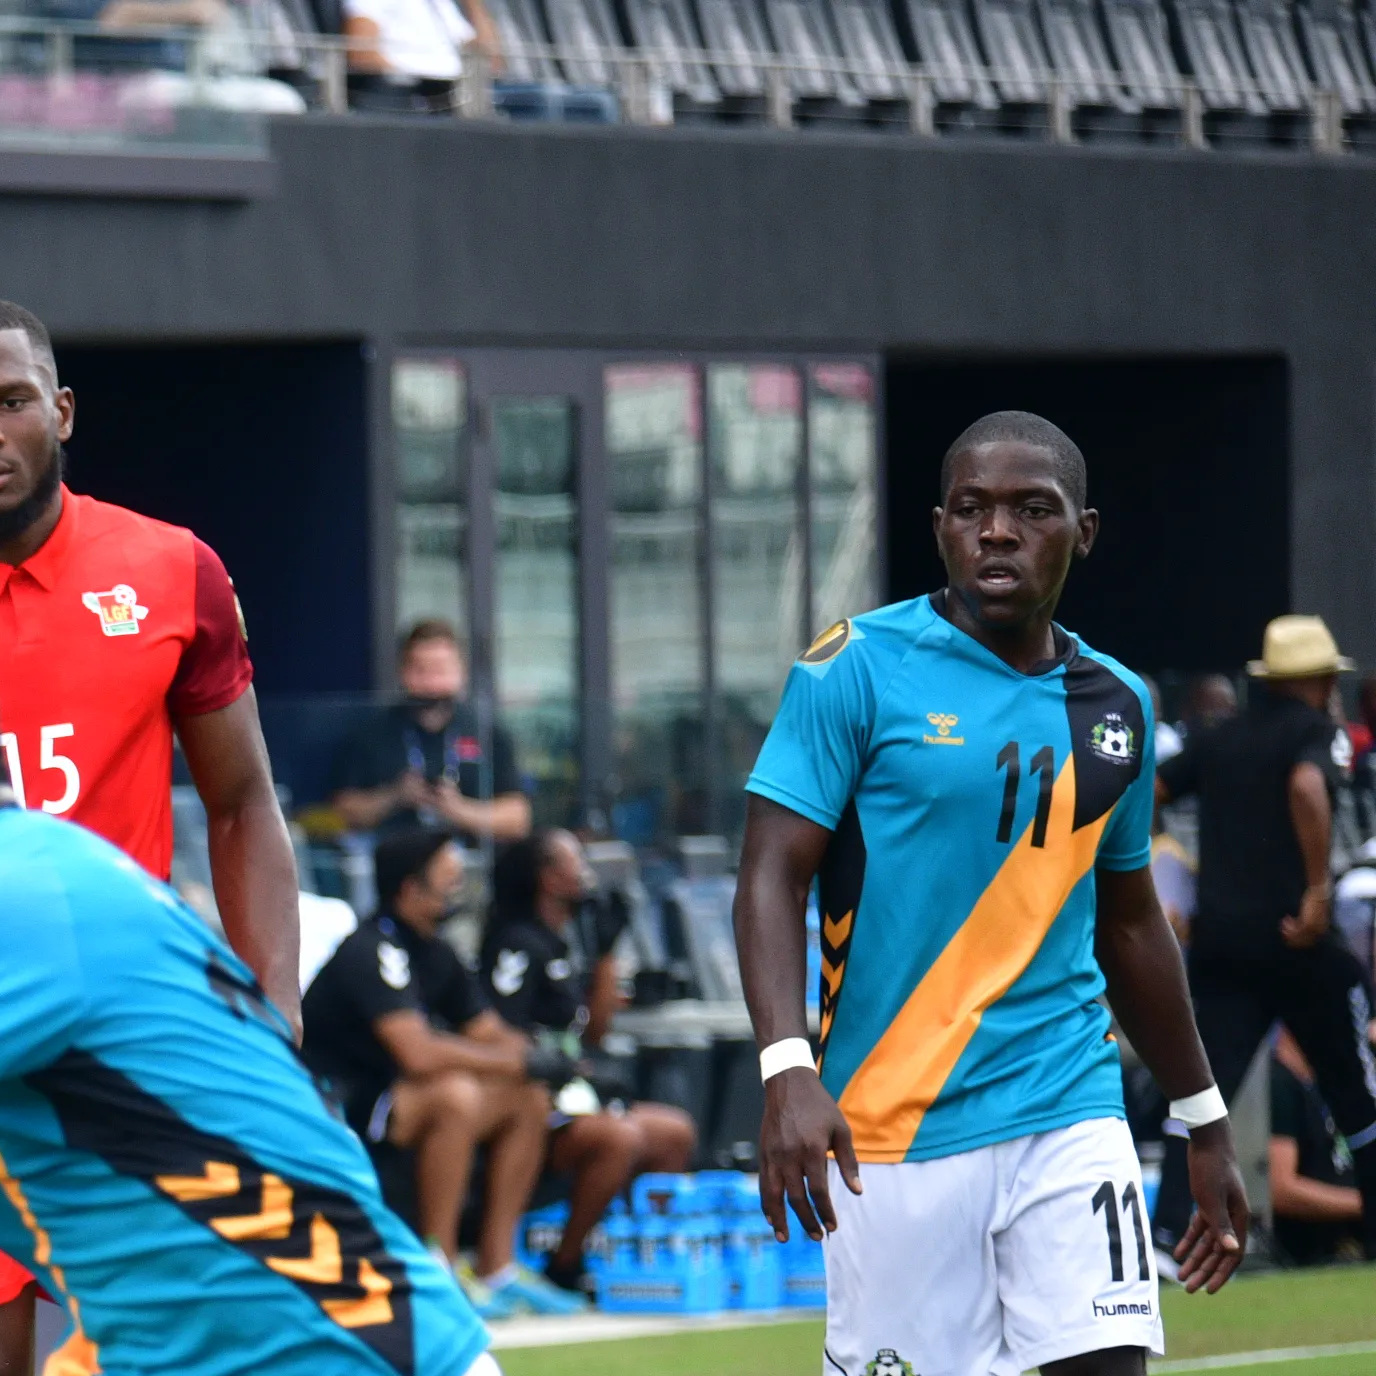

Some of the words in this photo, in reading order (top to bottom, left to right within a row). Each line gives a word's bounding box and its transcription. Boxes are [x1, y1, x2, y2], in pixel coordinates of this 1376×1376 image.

[102, 603, 131, 622] LGF
[996, 741, 1054, 848] 11
[1091, 1180, 1151, 1282] 11
[1092, 1300, 1153, 1317] hummel
